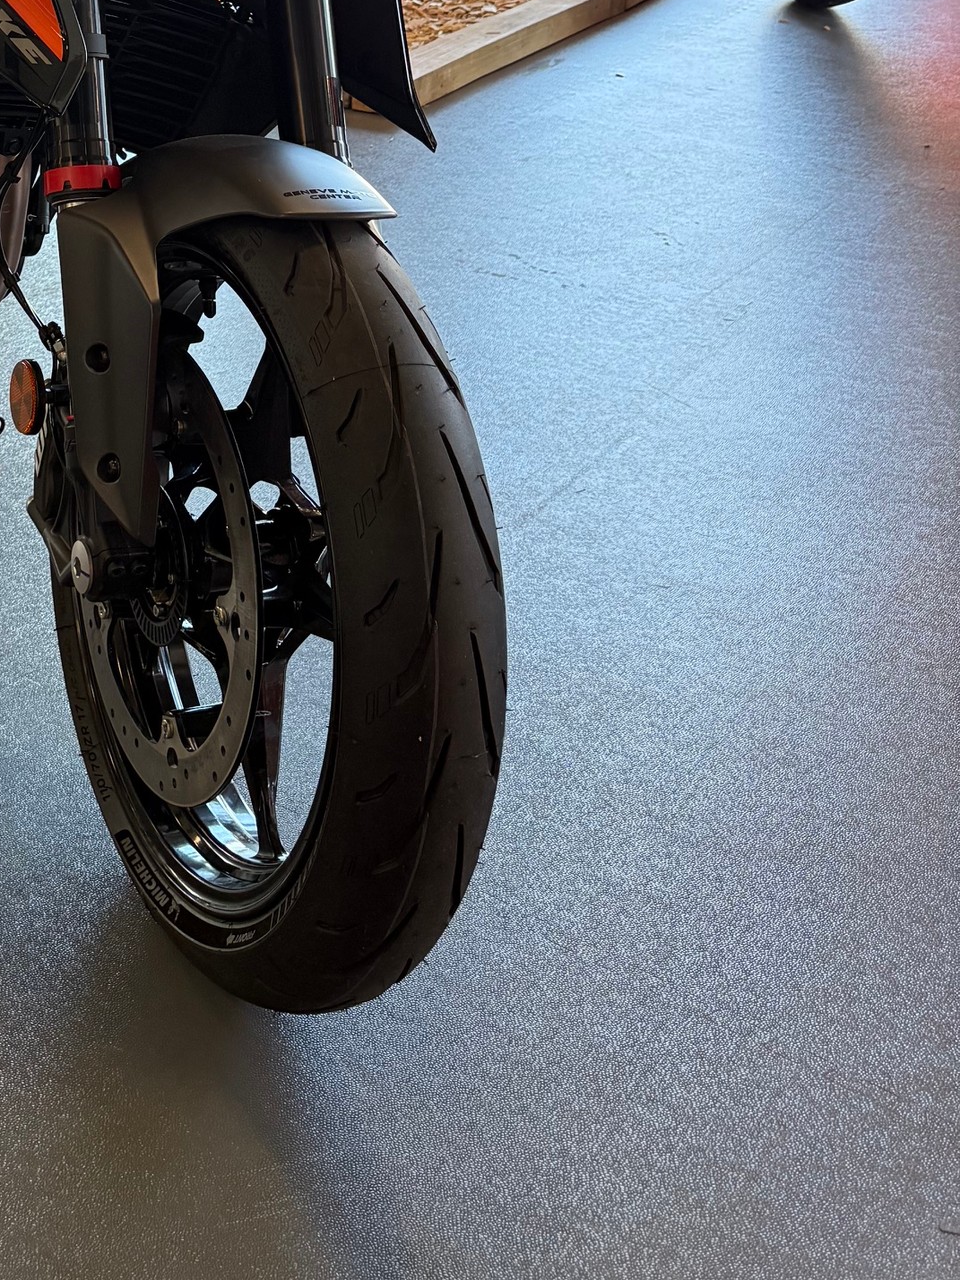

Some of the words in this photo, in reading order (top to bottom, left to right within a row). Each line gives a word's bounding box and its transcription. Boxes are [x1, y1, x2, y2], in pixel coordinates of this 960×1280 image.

[283, 188, 336, 198] GENEVE
[310, 193, 362, 201] CENTER
[120, 836, 170, 908] MICHELIN
